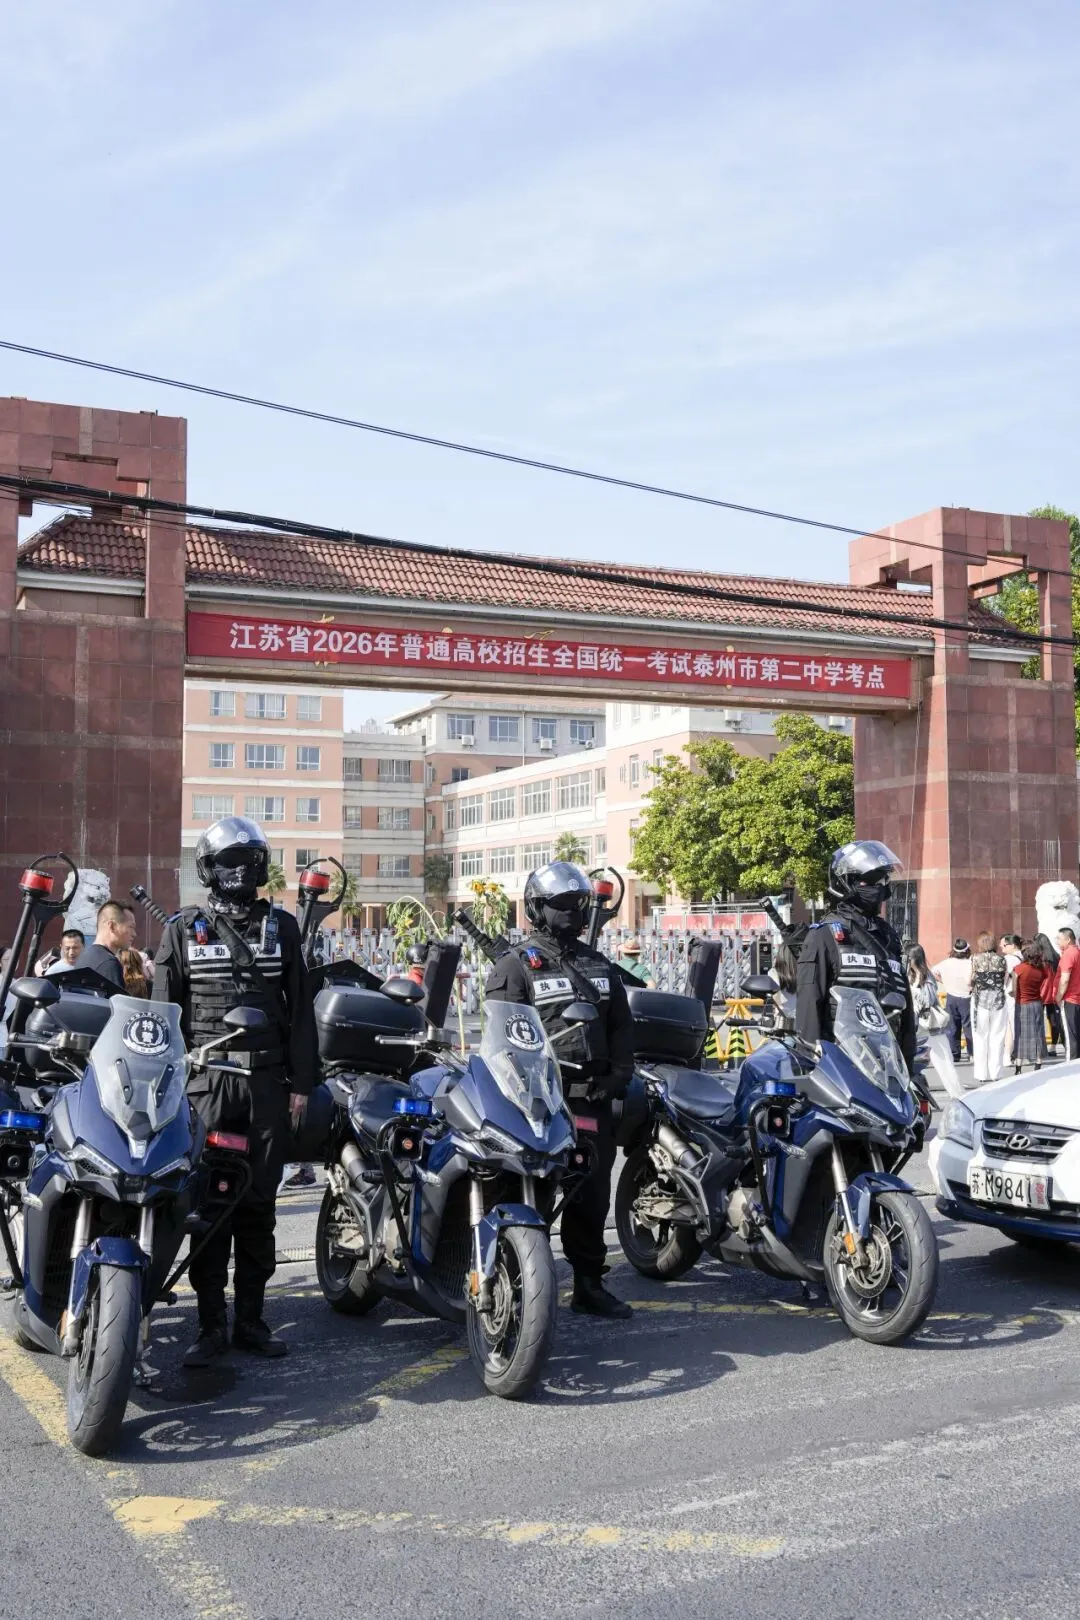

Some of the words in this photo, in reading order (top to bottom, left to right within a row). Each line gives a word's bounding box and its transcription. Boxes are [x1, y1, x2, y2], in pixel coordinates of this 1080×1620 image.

[229, 621, 886, 690] 江苏省2026年普通高校招生全国统一考试泰州市第二中学考点
[194, 947, 226, 957] 执勤
